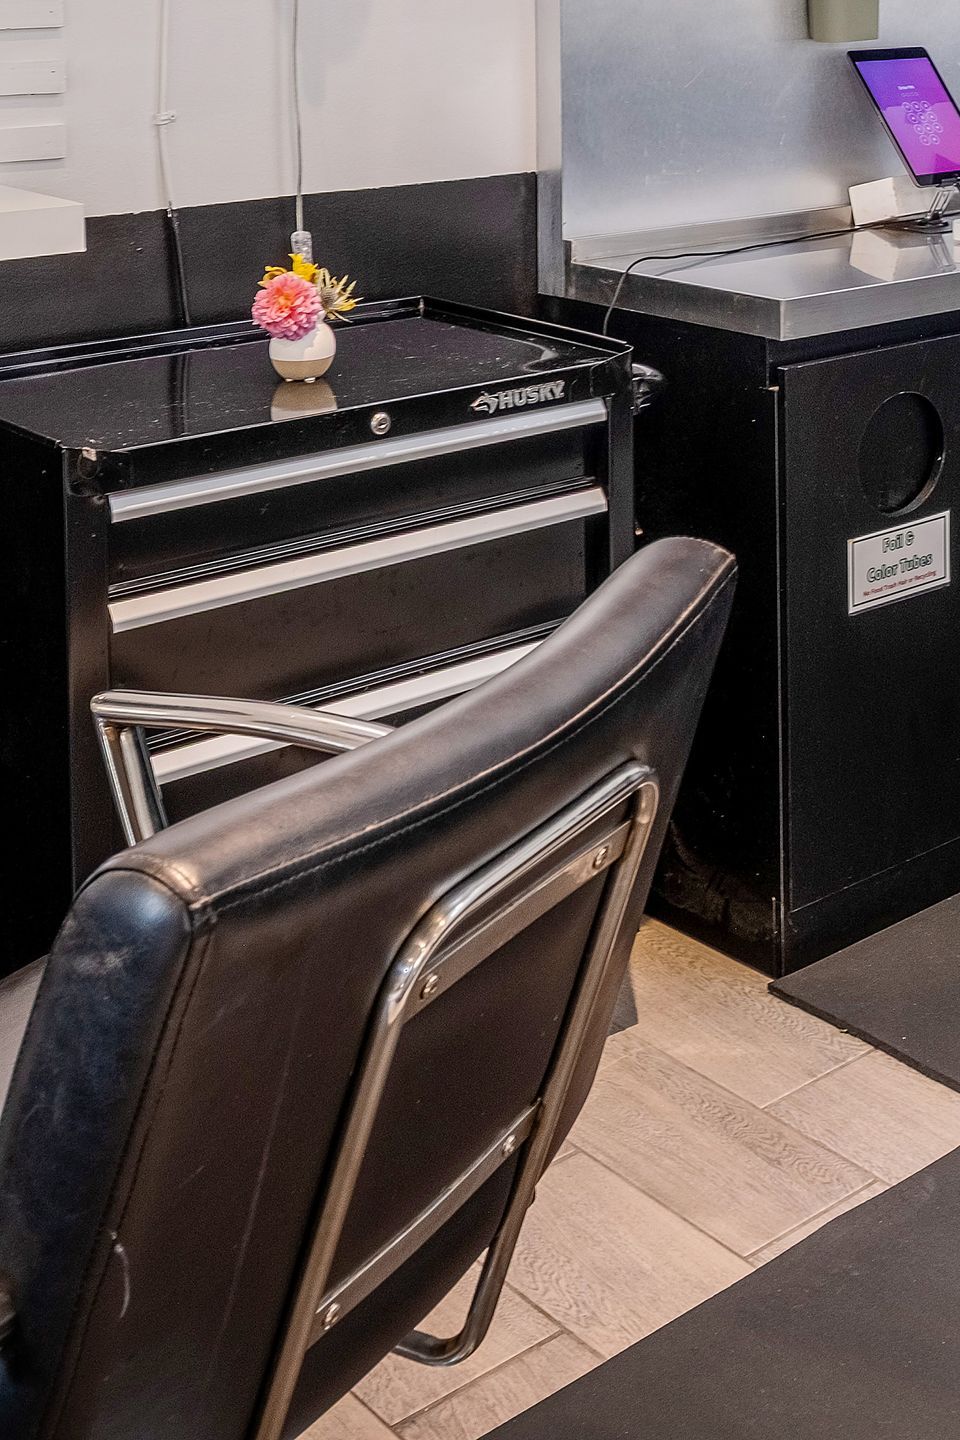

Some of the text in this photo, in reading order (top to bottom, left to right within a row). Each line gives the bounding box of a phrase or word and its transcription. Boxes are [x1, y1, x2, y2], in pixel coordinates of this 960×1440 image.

[499, 380, 565, 410] HUSKY
[882, 533, 903, 554] Foil
[866, 553, 933, 583] Color Tubes
